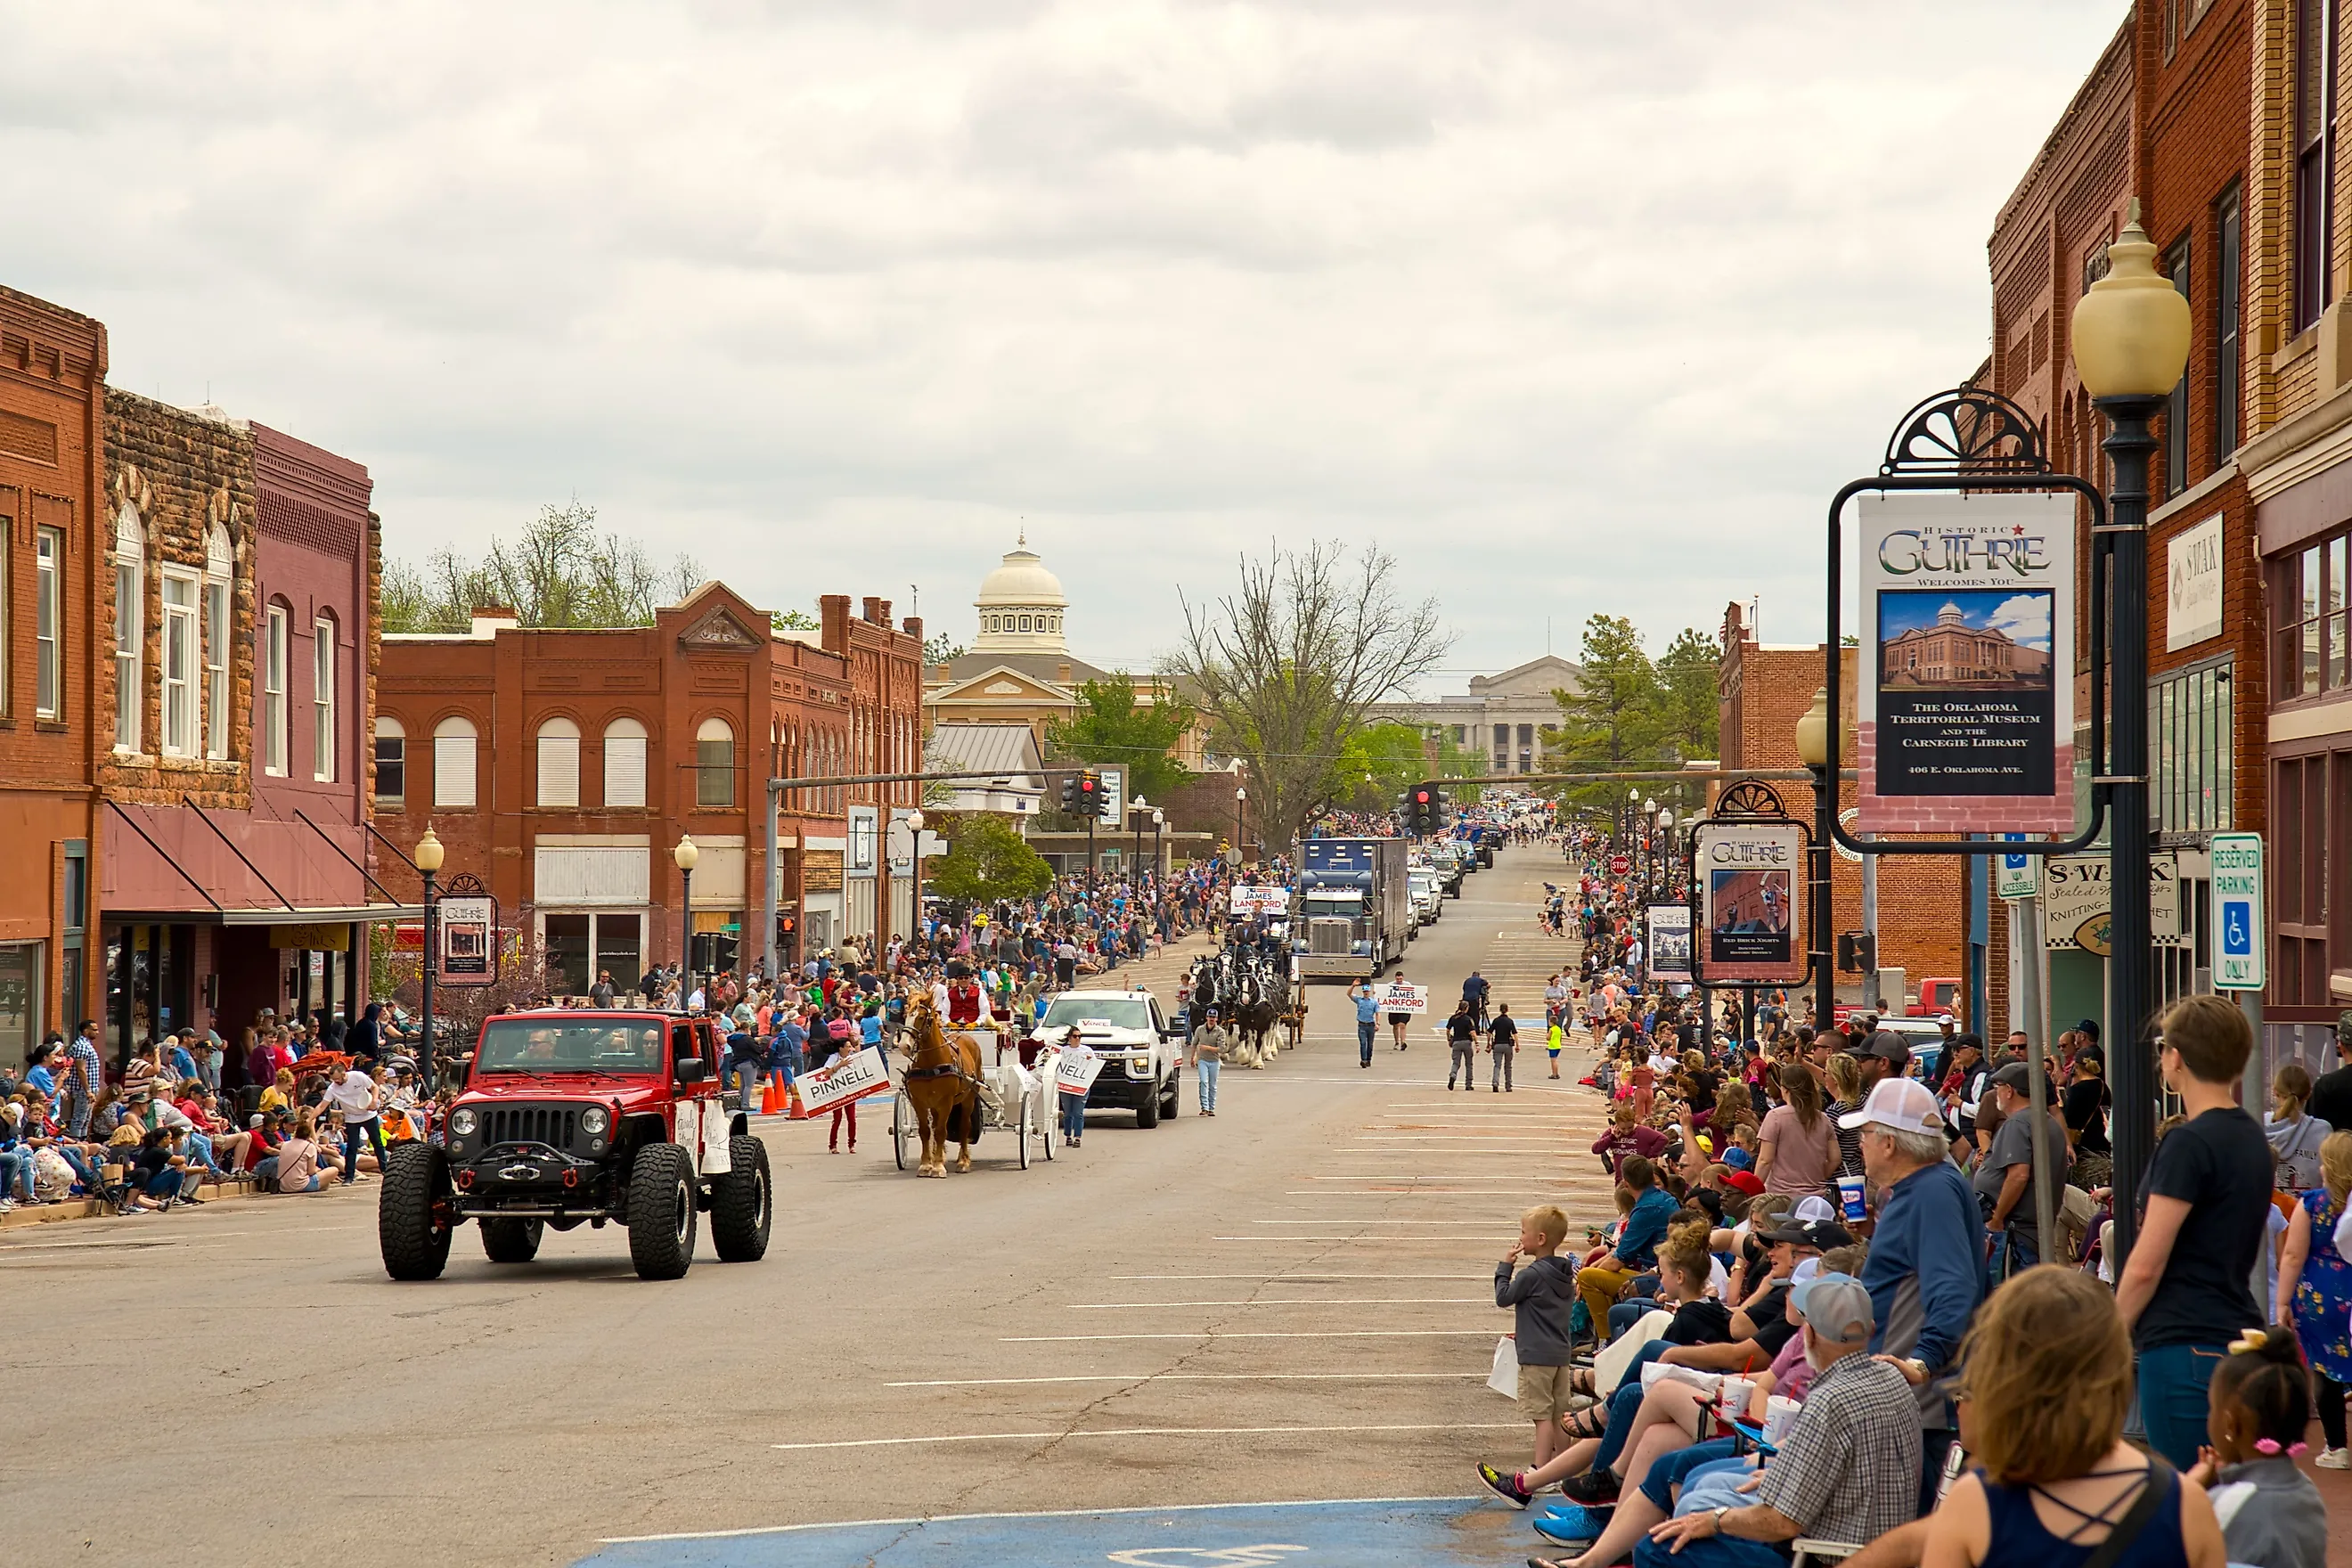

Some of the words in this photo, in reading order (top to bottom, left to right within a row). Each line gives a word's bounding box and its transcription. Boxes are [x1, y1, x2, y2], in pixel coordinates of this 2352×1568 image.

[1924, 527, 2008, 535] HISTORIC
[1878, 530, 2052, 576] GUTHRIE
[1990, 578, 2014, 586] YOU
[1912, 703, 1940, 713] THE
[1944, 703, 2019, 712] OKLAHOMA
[1891, 715, 1980, 724] TERRITORIAL
[1982, 715, 2041, 723] MUSEUM
[1902, 739, 1969, 747] CARNEGIE
[1972, 738, 2029, 747] LIBRARY
[1907, 766, 1929, 774] 406
[1943, 766, 1999, 774] OKLAHOMA
[2000, 766, 2024, 774] AVE.
[1711, 842, 1789, 864] GUTHRIE
[2215, 849, 2258, 869] RESERVED
[1612, 861, 1629, 870] STOP
[2012, 871, 2022, 879] VAN
[2002, 880, 2034, 892] ACCESSIBLE
[2217, 876, 2255, 894] PARKING
[1245, 891, 1272, 900] JAMES
[2049, 886, 2097, 900] Sealed
[446, 907, 485, 919] GUTHRIE
[2050, 901, 2105, 922] KNITTING
[2225, 960, 2250, 979] ONLY
[1388, 989, 1416, 999] JAMES
[1377, 998, 1425, 1008] LANKFORD
[1060, 1049, 1093, 1067] MATT
[1057, 1062, 1086, 1080] NELL
[810, 1067, 874, 1098] PINNELL
[813, 1089, 847, 1103] LIEUTENANT
[847, 1076, 876, 1090] GOVERNOR
[825, 1089, 872, 1110] MATTPINNELL.COM
